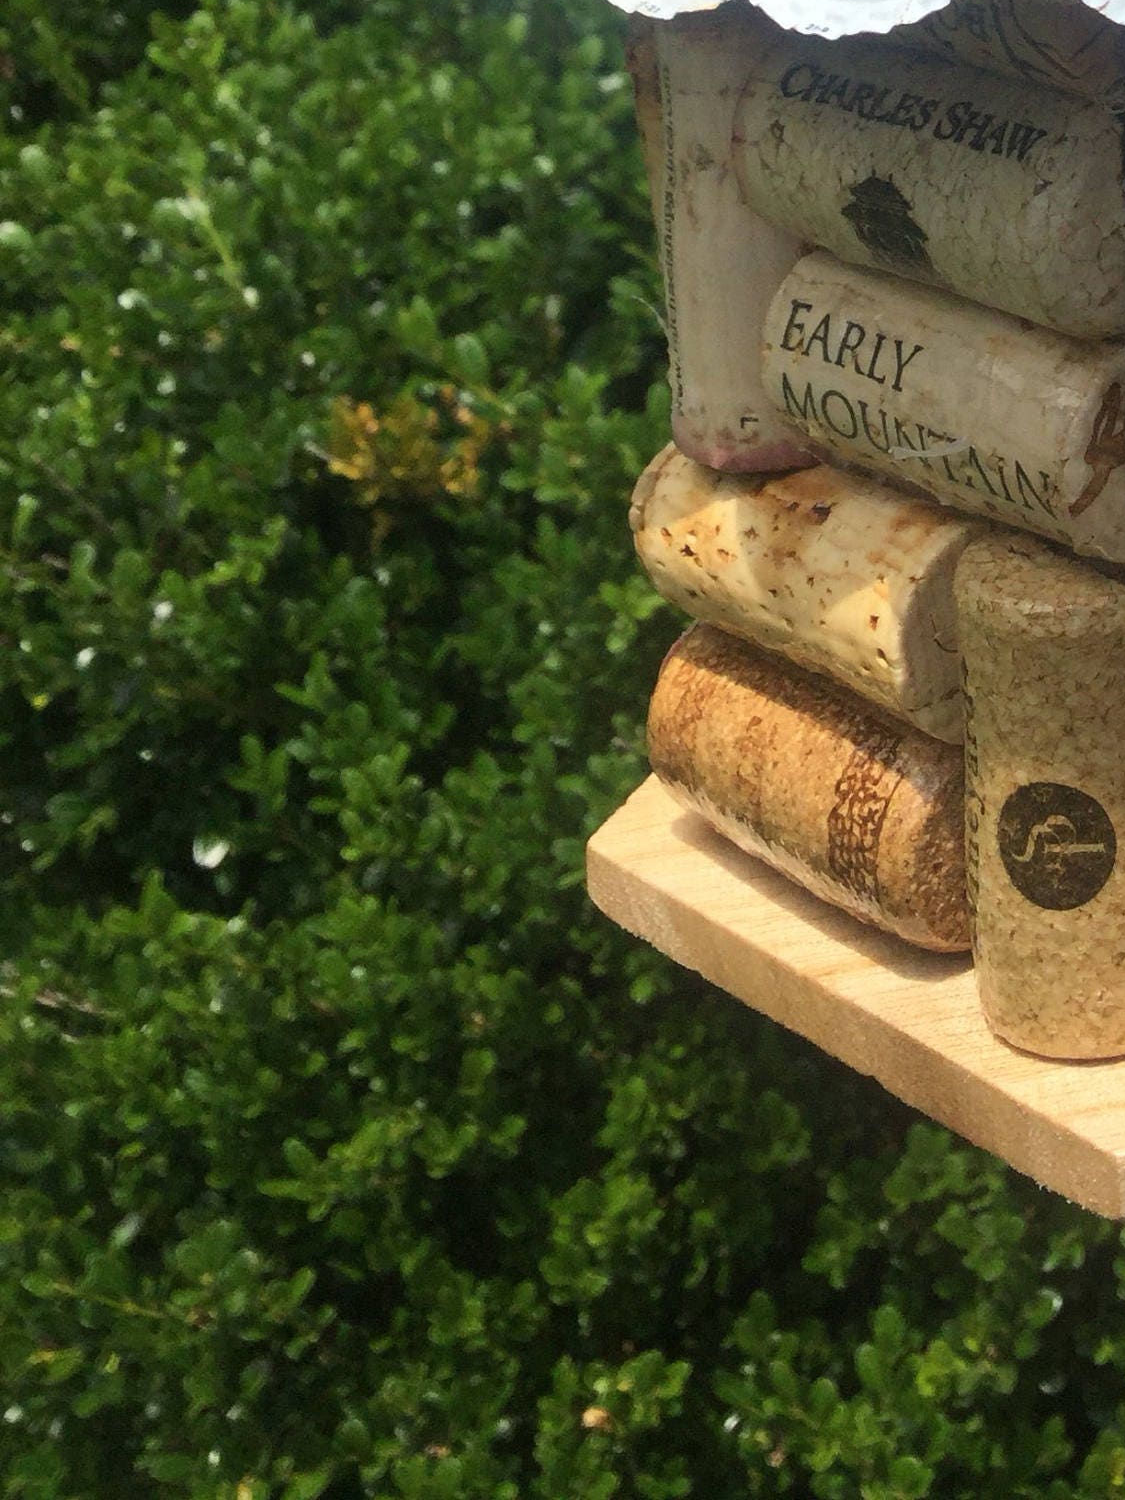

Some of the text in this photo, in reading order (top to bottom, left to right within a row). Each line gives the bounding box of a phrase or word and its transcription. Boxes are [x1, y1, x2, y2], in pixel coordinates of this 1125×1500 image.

[779, 59, 1049, 163] CHARLES SHAW
[780, 300, 926, 393] EARLY
[781, 372, 1059, 521] MOUNTAIN
